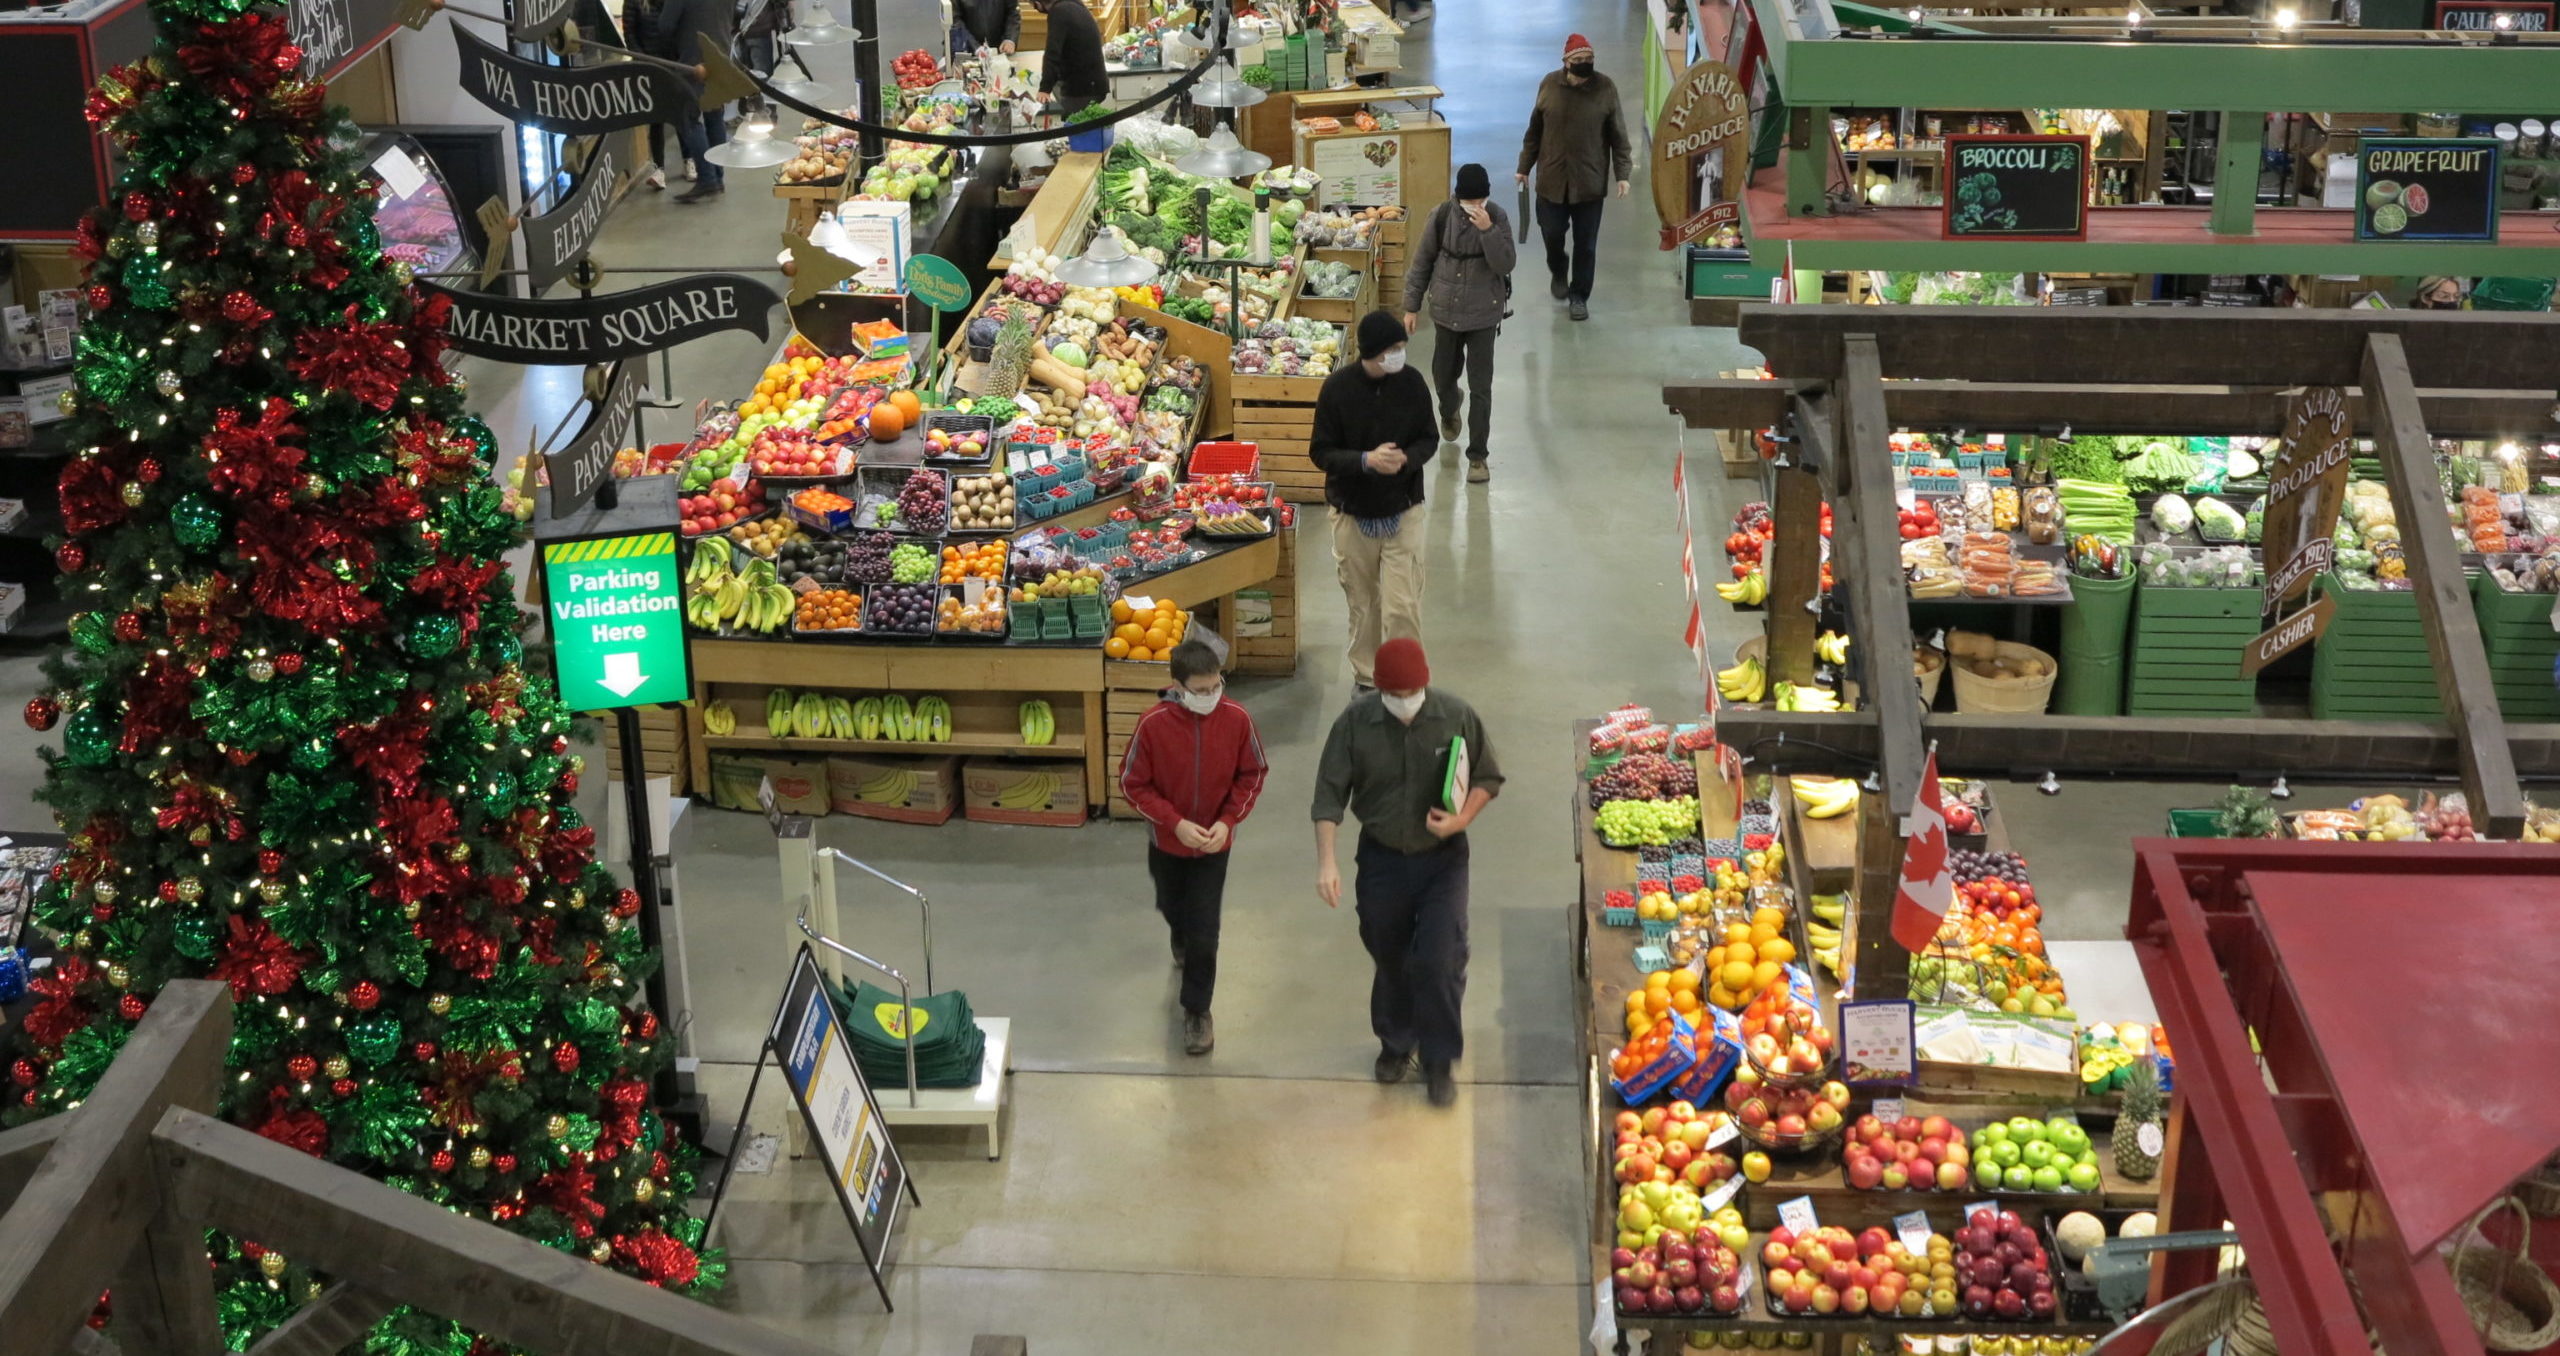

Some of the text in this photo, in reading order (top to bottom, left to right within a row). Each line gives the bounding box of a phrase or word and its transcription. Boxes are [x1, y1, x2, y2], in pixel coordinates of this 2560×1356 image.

[1666, 115, 1745, 160] PRODUCE
[1960, 148, 2046, 169] BROCCOLI
[2369, 150, 2488, 172] GRAPEFRUIT
[553, 151, 616, 267] ELEVATOR
[1684, 207, 1731, 239] Since 1912
[449, 286, 738, 350] MARKET SQUARE
[573, 371, 635, 497] PARKING
[2269, 437, 2349, 507] PRODUCE
[569, 568, 660, 593] Parking
[2272, 546, 2326, 597] Since 1912
[554, 593, 679, 620] Validation
[592, 624, 647, 643] Here
[2260, 612, 2315, 661] CASHIER
